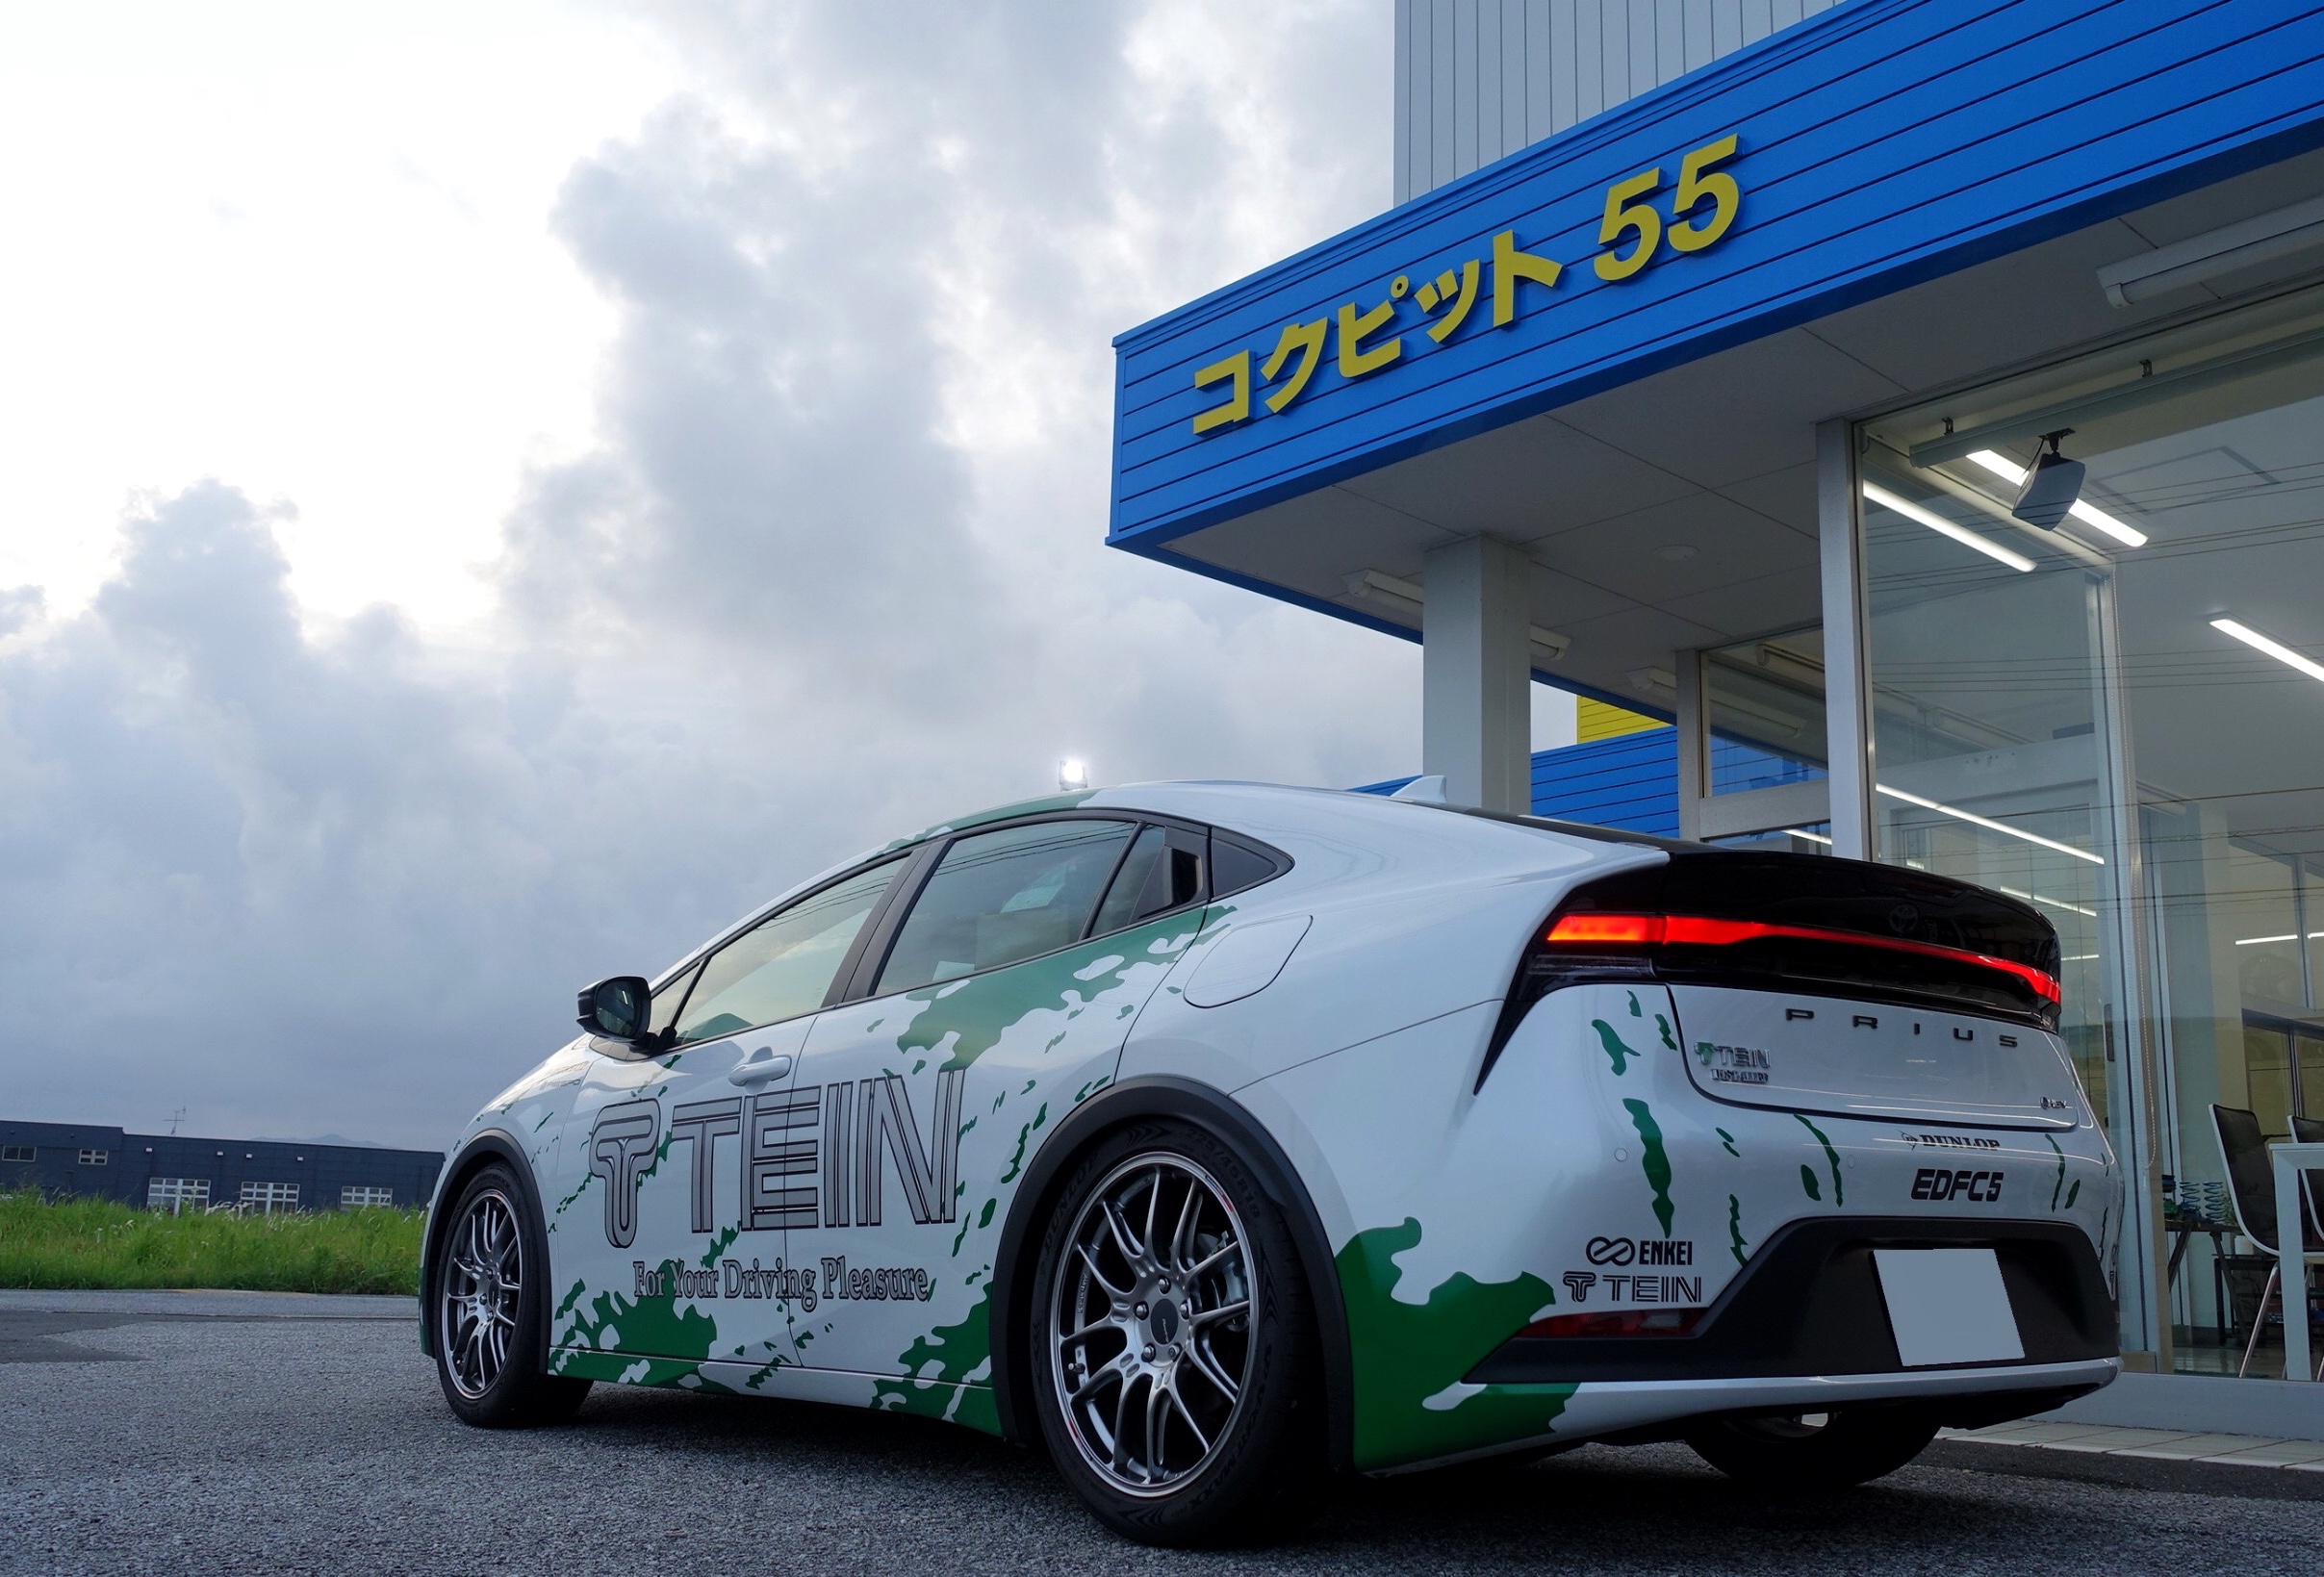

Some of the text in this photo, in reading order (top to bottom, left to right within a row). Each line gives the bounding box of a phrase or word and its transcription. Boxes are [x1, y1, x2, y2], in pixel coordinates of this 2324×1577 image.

[1192, 132, 1745, 437] コクピット 55
[1785, 1007, 2018, 1048] PRIUS
[673, 1068, 966, 1234] TEIN
[1919, 1133, 2001, 1152] DUNLOP
[1910, 1168, 2005, 1202] EDFC5
[1639, 1240, 1693, 1265] ENKEI
[633, 1256, 929, 1312] For Your Driving Pleasure
[1602, 1275, 1701, 1303] TEIN
